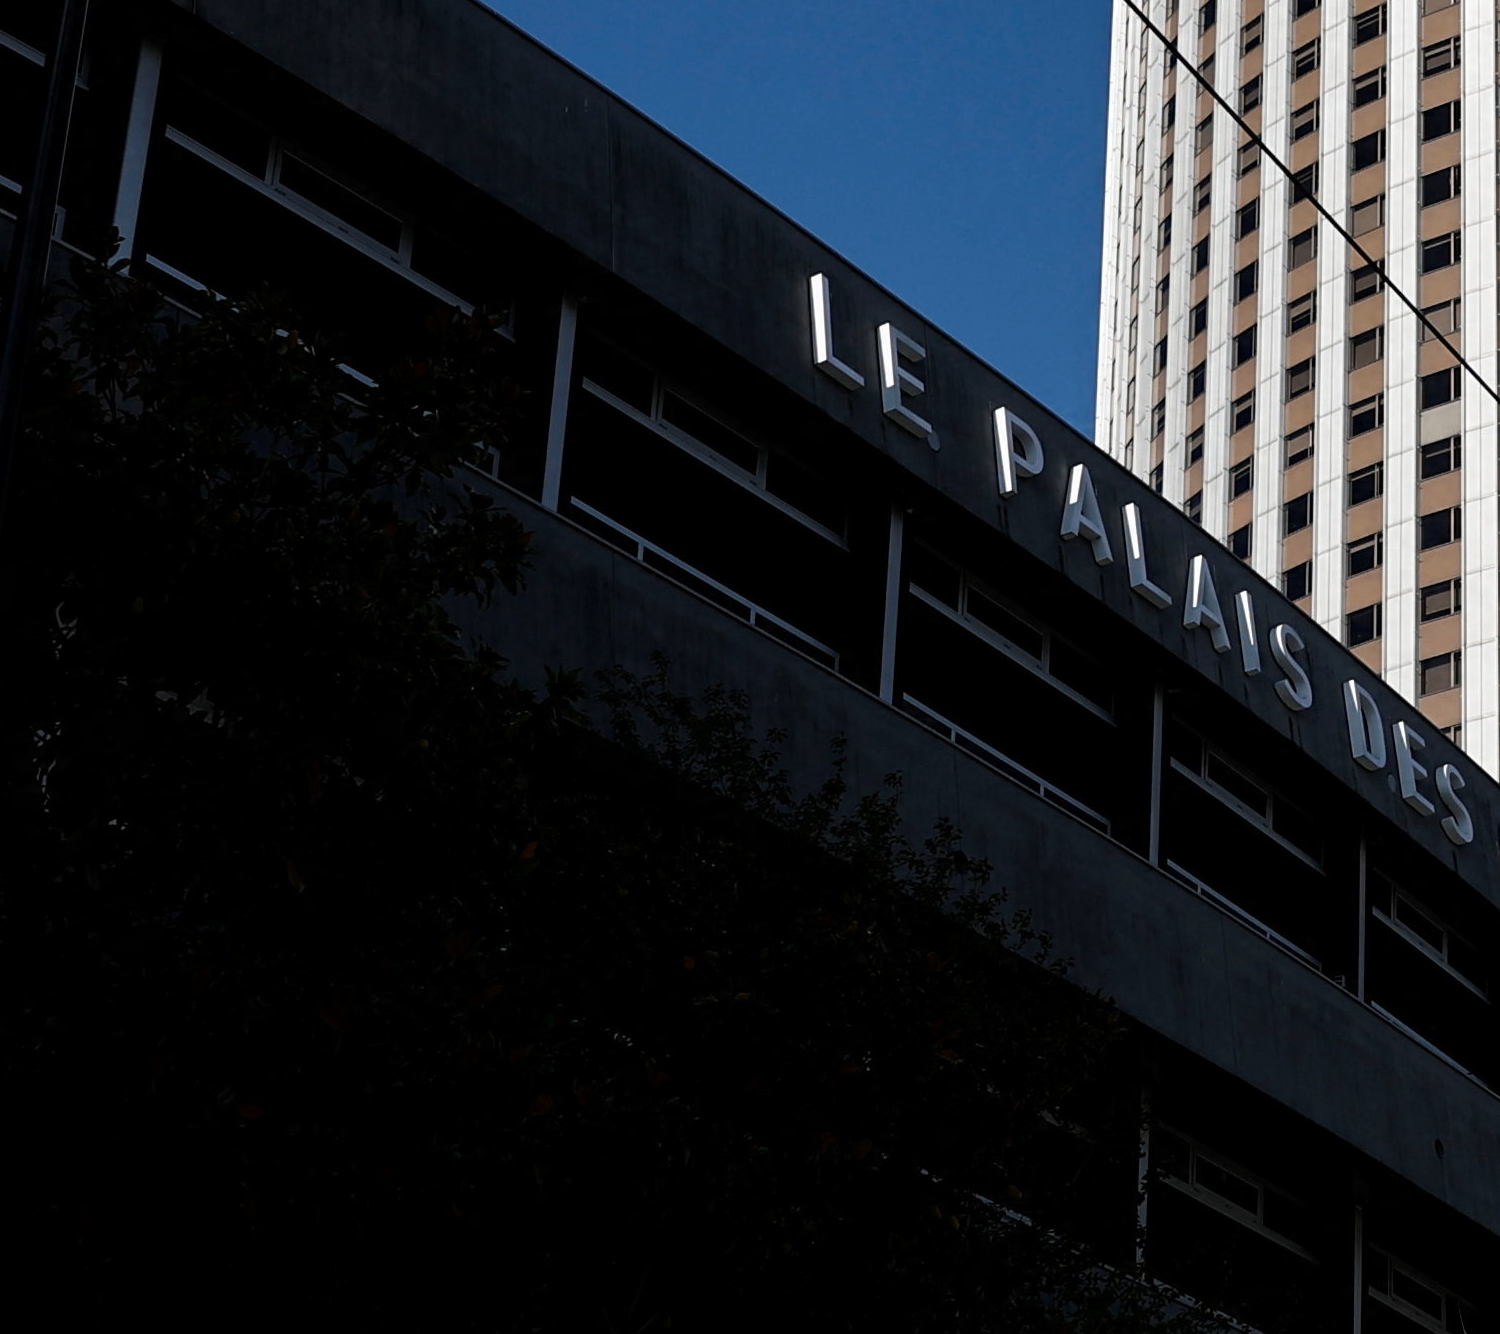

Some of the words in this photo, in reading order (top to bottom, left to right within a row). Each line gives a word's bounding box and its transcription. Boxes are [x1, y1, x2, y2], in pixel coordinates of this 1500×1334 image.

[808, 272, 933, 438] LE
[991, 405, 1314, 712] PALAIS
[1342, 678, 1474, 846] DES
